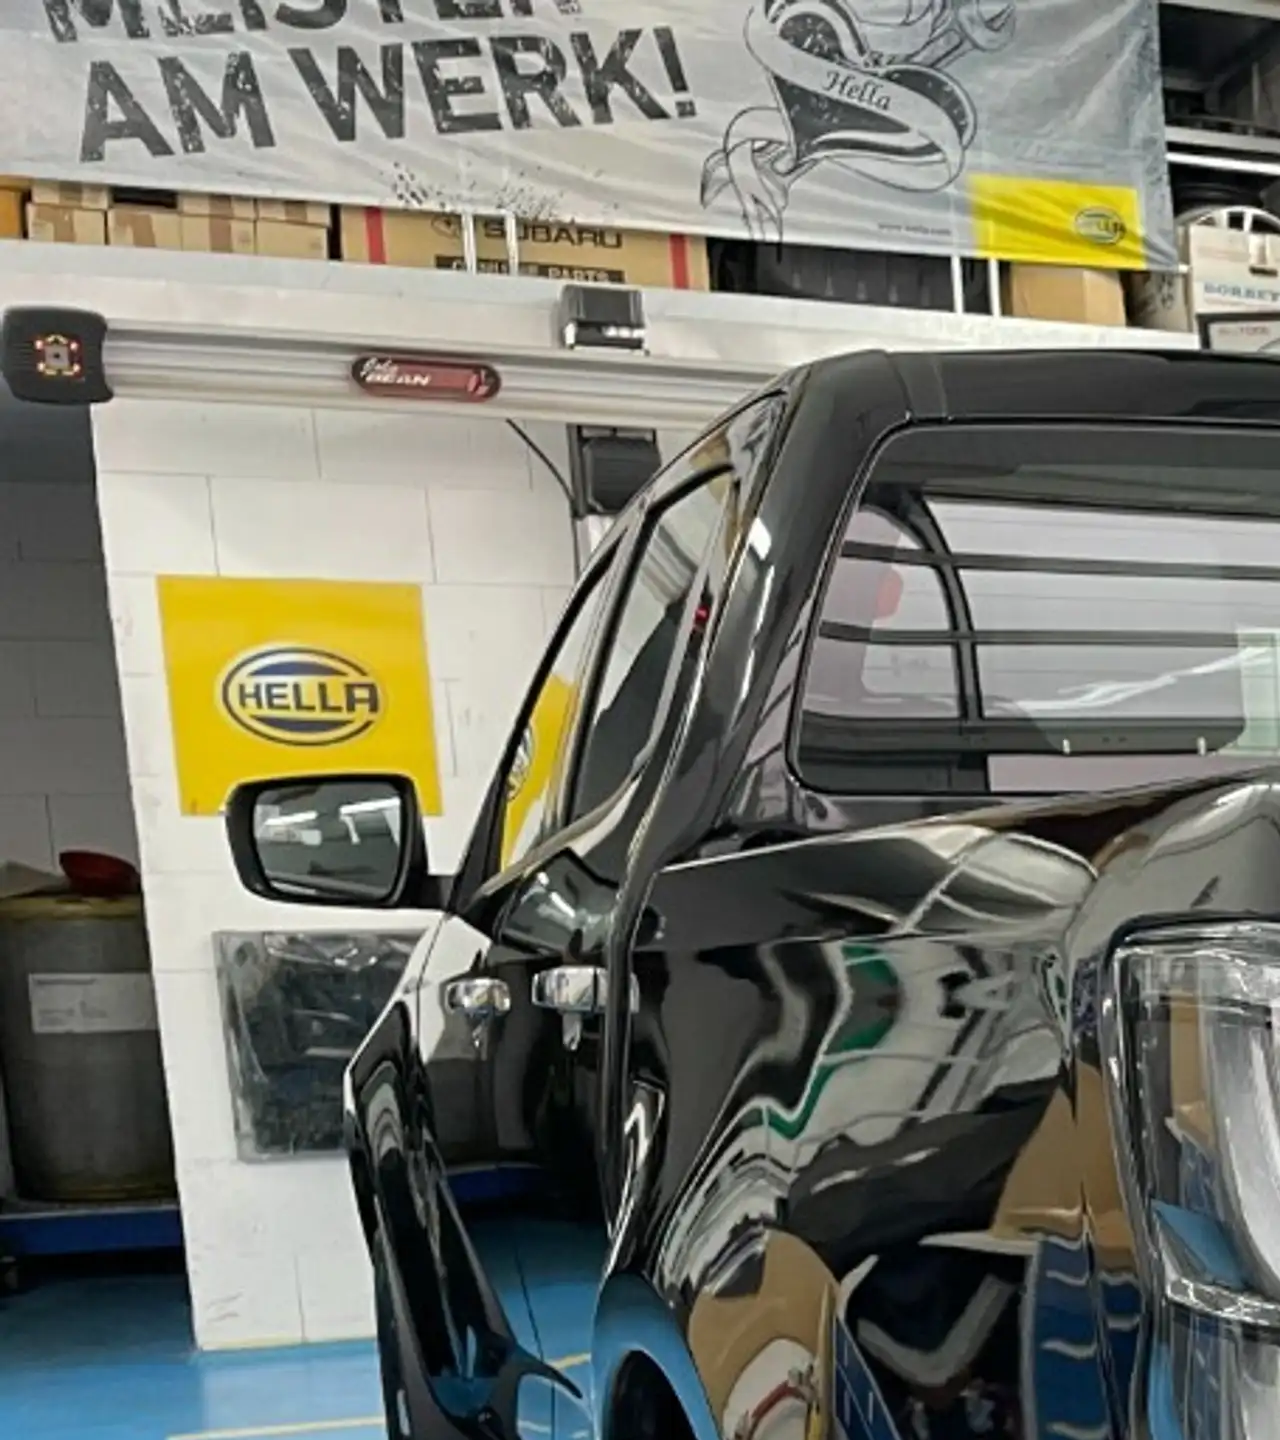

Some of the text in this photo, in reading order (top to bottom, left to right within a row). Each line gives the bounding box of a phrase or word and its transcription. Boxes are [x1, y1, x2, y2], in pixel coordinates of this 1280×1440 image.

[80, 27, 697, 163] AM WERK!
[822, 71, 893, 112] Hella
[237, 681, 379, 714] HELLA
